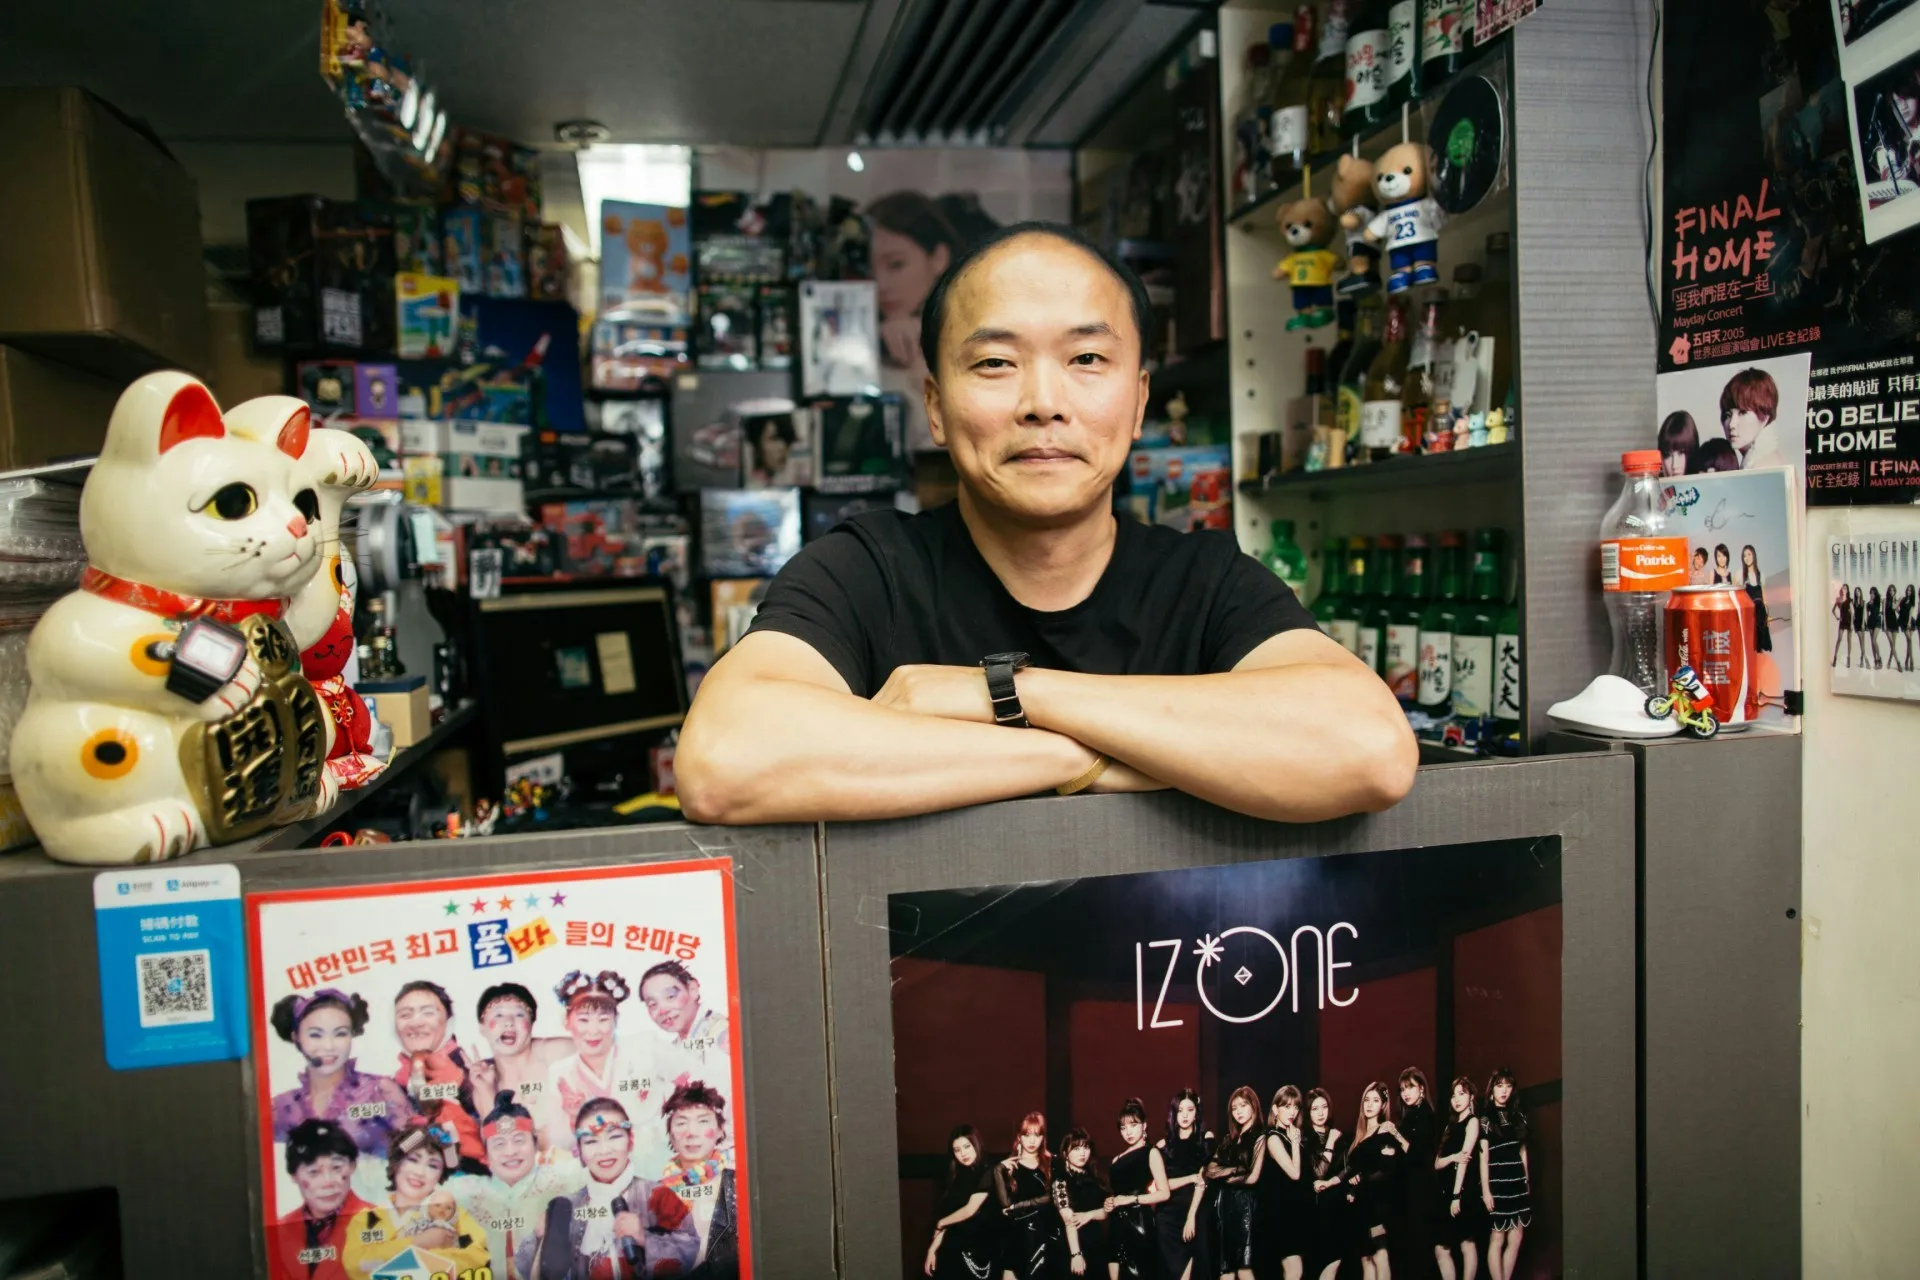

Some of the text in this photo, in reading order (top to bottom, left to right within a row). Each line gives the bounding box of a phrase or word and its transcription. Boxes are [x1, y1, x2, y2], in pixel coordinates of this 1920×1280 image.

[1674, 178, 1781, 241] FINAL
[1395, 221, 1416, 240] 23
[1671, 230, 1776, 281] HOME
[1673, 305, 1744, 329] Mayday Concert
[1721, 327, 1745, 342] 2005
[1817, 428, 1897, 454] HOME
[1635, 554, 1677, 566] Patrick
[285, 937, 398, 990] 대한민국
[404, 928, 460, 960] 최고
[564, 920, 615, 948] 들의
[624, 923, 702, 961] 한마당
[490, 1215, 525, 1231] 이상진
